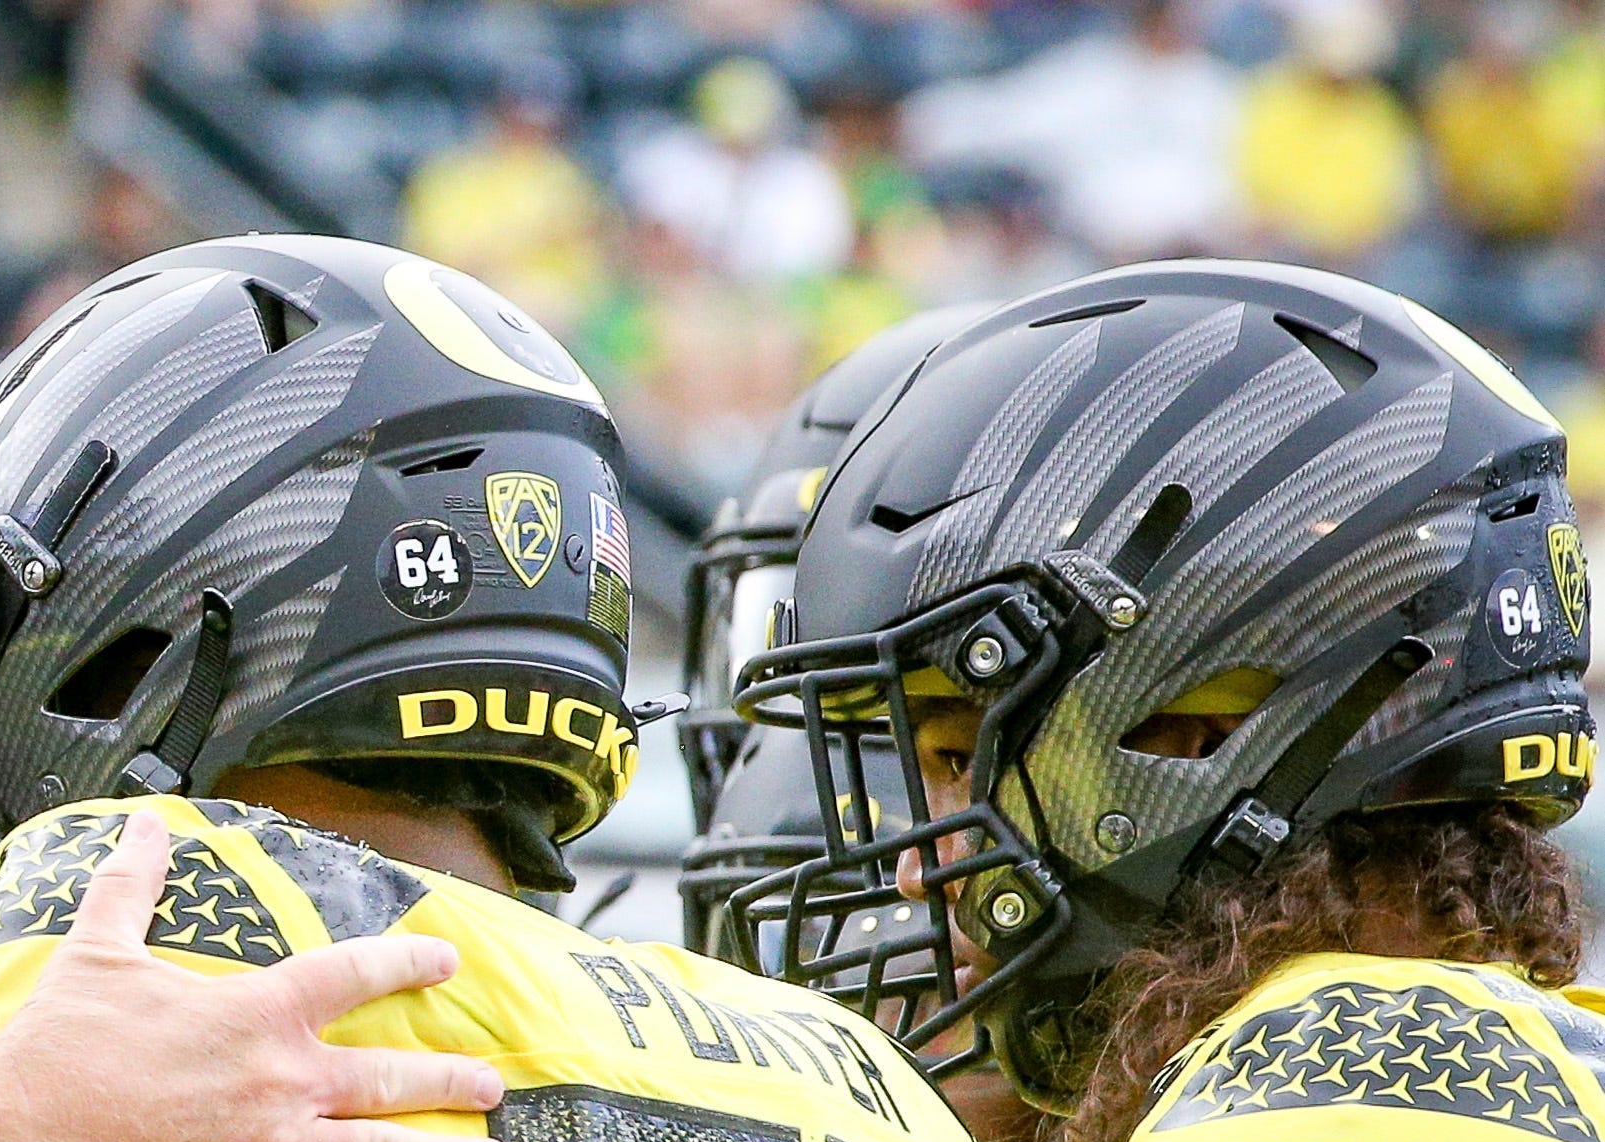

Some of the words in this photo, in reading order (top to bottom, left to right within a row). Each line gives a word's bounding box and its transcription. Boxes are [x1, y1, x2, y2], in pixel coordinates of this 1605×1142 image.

[395, 534, 460, 588] 64
[512, 521, 549, 562] 12
[1498, 583, 1543, 637] 64
